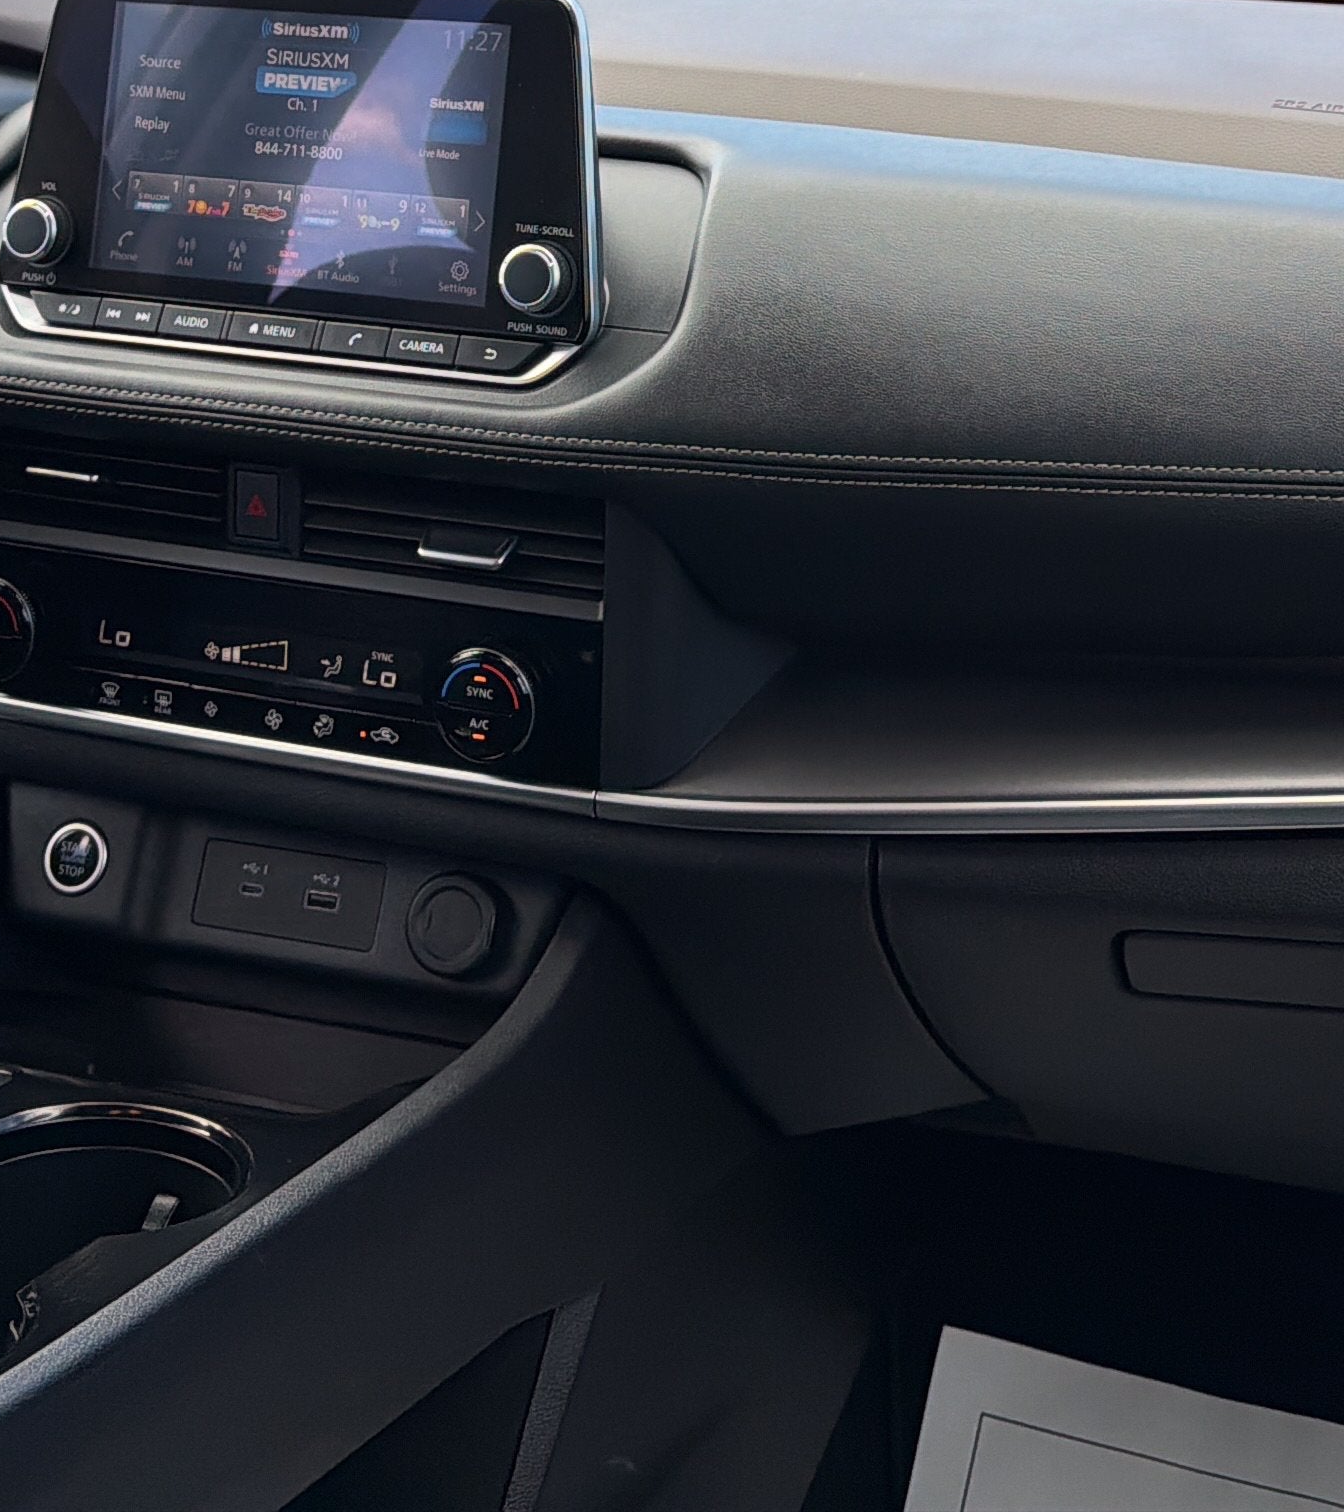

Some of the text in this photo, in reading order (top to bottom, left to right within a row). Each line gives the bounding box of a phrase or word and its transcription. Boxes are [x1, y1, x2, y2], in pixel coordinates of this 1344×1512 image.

[444, 30, 502, 52] 11:27
[140, 54, 181, 69] Source
[129, 84, 186, 101] SXM Menu
[287, 98, 318, 112] Ch. 1
[429, 97, 484, 112] SiriusXM
[134, 116, 170, 134] Replay
[245, 123, 280, 139] Great
[284, 124, 320, 140] Offer
[254, 141, 343, 161] 844-711-8800
[436, 148, 460, 160] Mode
[41, 181, 57, 192] VOL
[188, 183, 195, 194] 8
[228, 185, 235, 198] 7
[244, 188, 251, 199] 9
[278, 189, 292, 203] 14
[299, 191, 311, 203] 10
[399, 199, 407, 213] 9
[415, 202, 427, 214] 12
[110, 249, 138, 262] Phone
[176, 257, 193, 267] AM
[228, 261, 242, 272] FM
[21, 272, 45, 283] PUSH
[317, 269, 360, 284] BT Audio
[438, 280, 477, 297] Settings
[174, 315, 209, 329] AUDIO
[507, 321, 568, 337] PUSH SOUND
[262, 323, 296, 338] MENU
[399, 339, 444, 355] CAMERA
[99, 619, 131, 647] Lo
[370, 650, 395, 664] SYNC
[362, 659, 397, 688] Lo
[466, 685, 495, 701] SYNC
[469, 717, 489, 731] A/C
[60, 840, 92, 856] STAT
[58, 863, 85, 878] STOP
